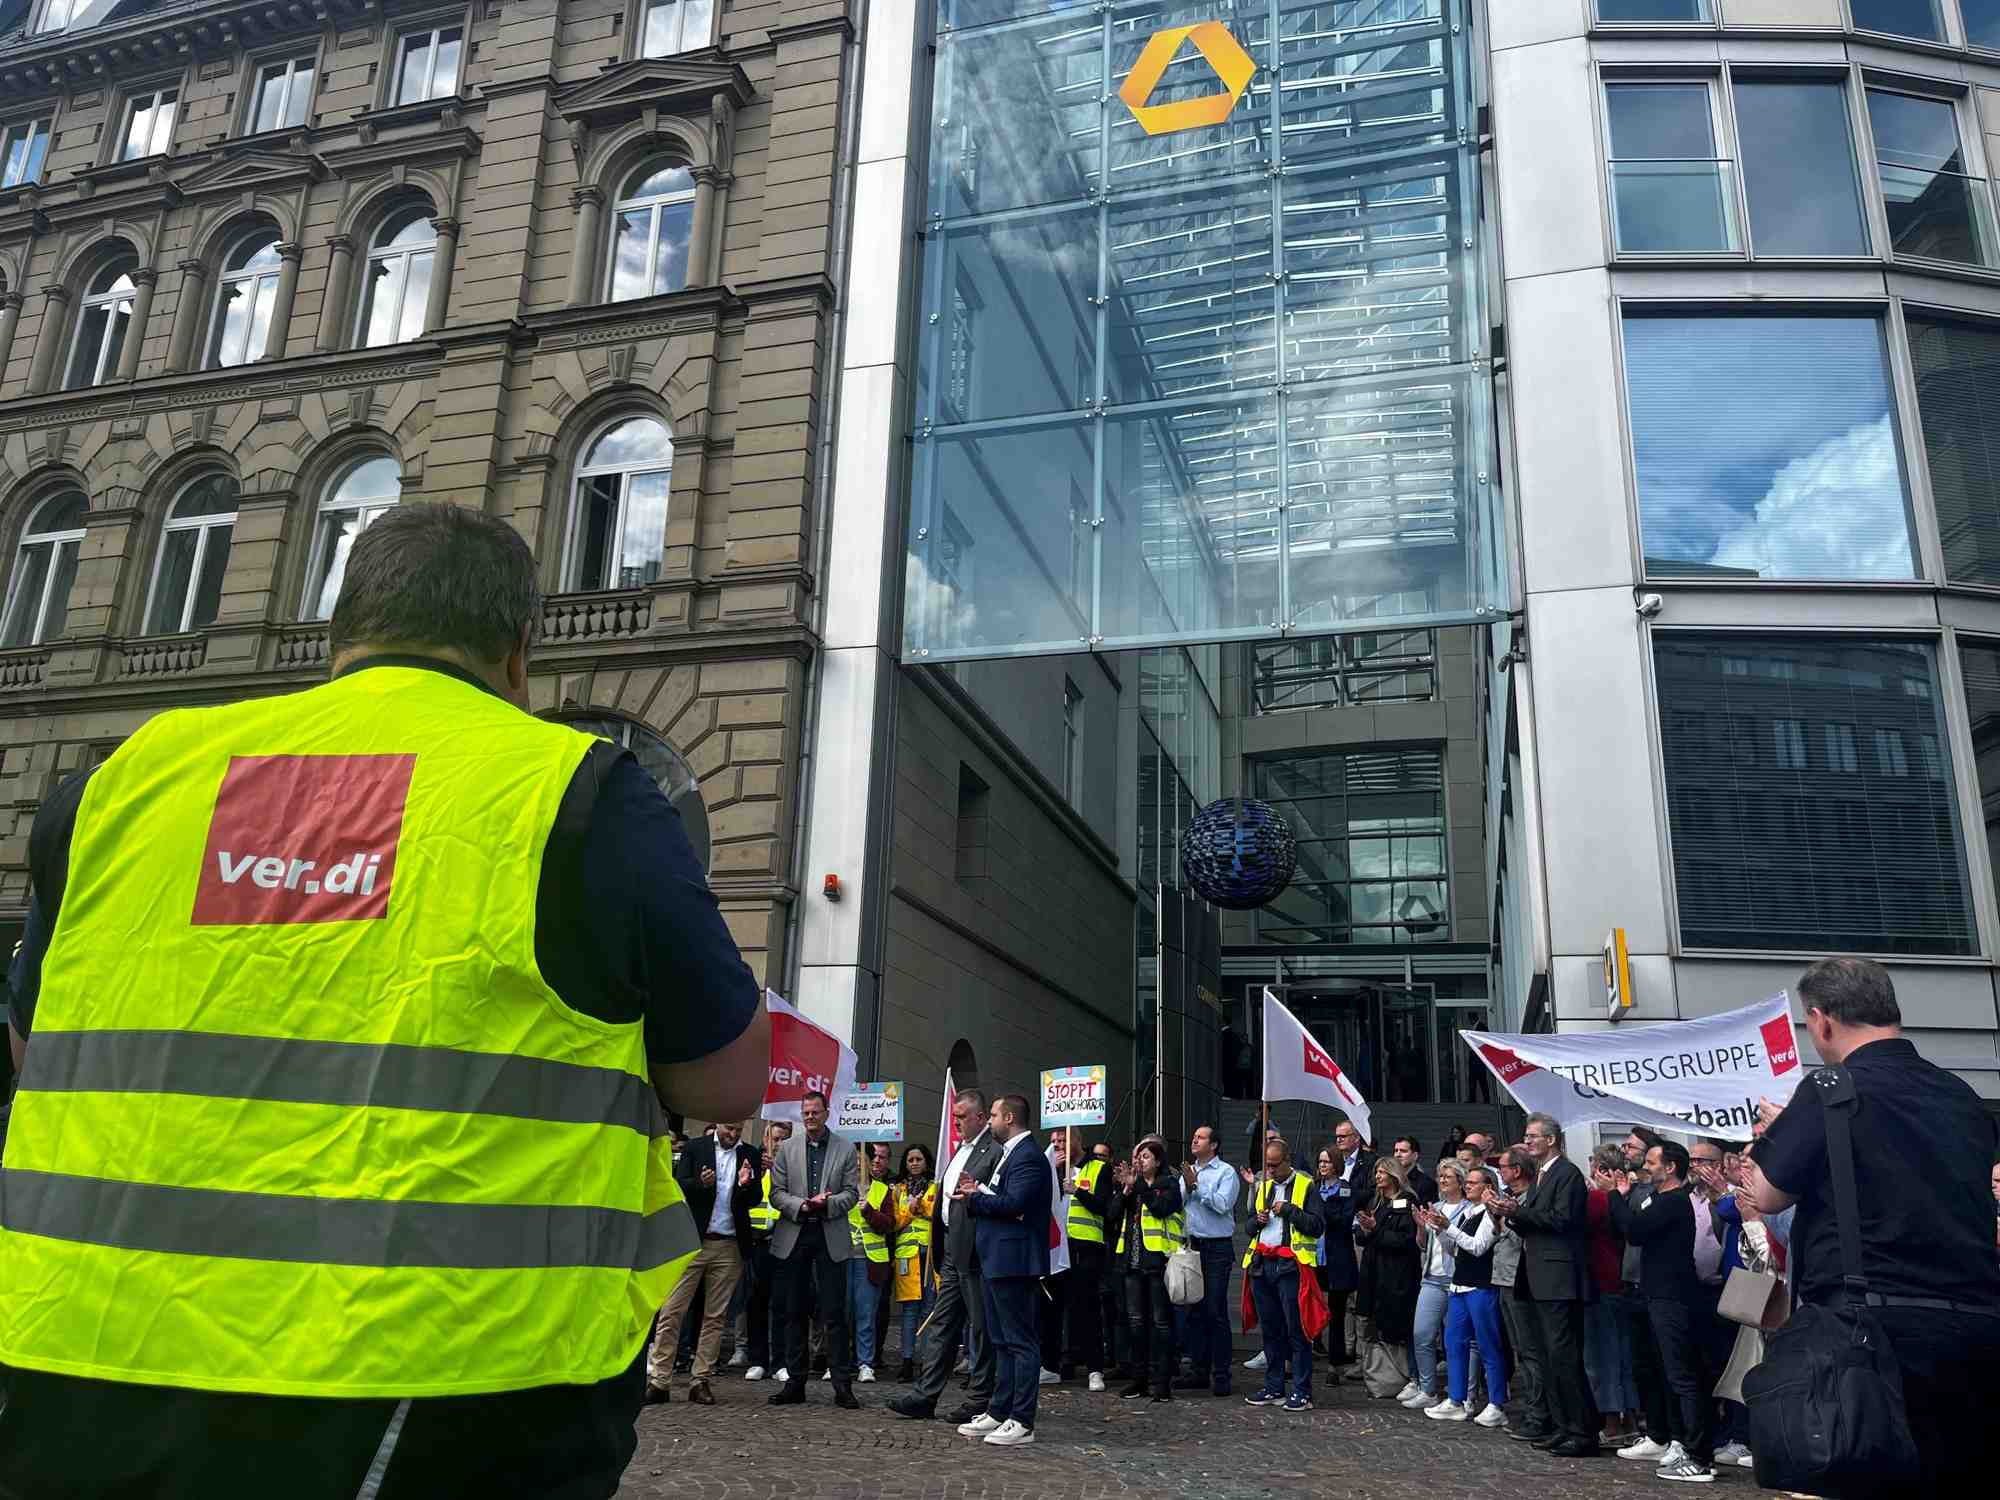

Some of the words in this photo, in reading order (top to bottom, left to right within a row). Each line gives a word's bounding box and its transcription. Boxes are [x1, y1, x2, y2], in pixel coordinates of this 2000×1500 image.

[217, 851, 382, 896] ver.di
[1551, 1043, 1760, 1087] TRIEBSGRUPPE
[1048, 1082, 1097, 1099] STOPPT
